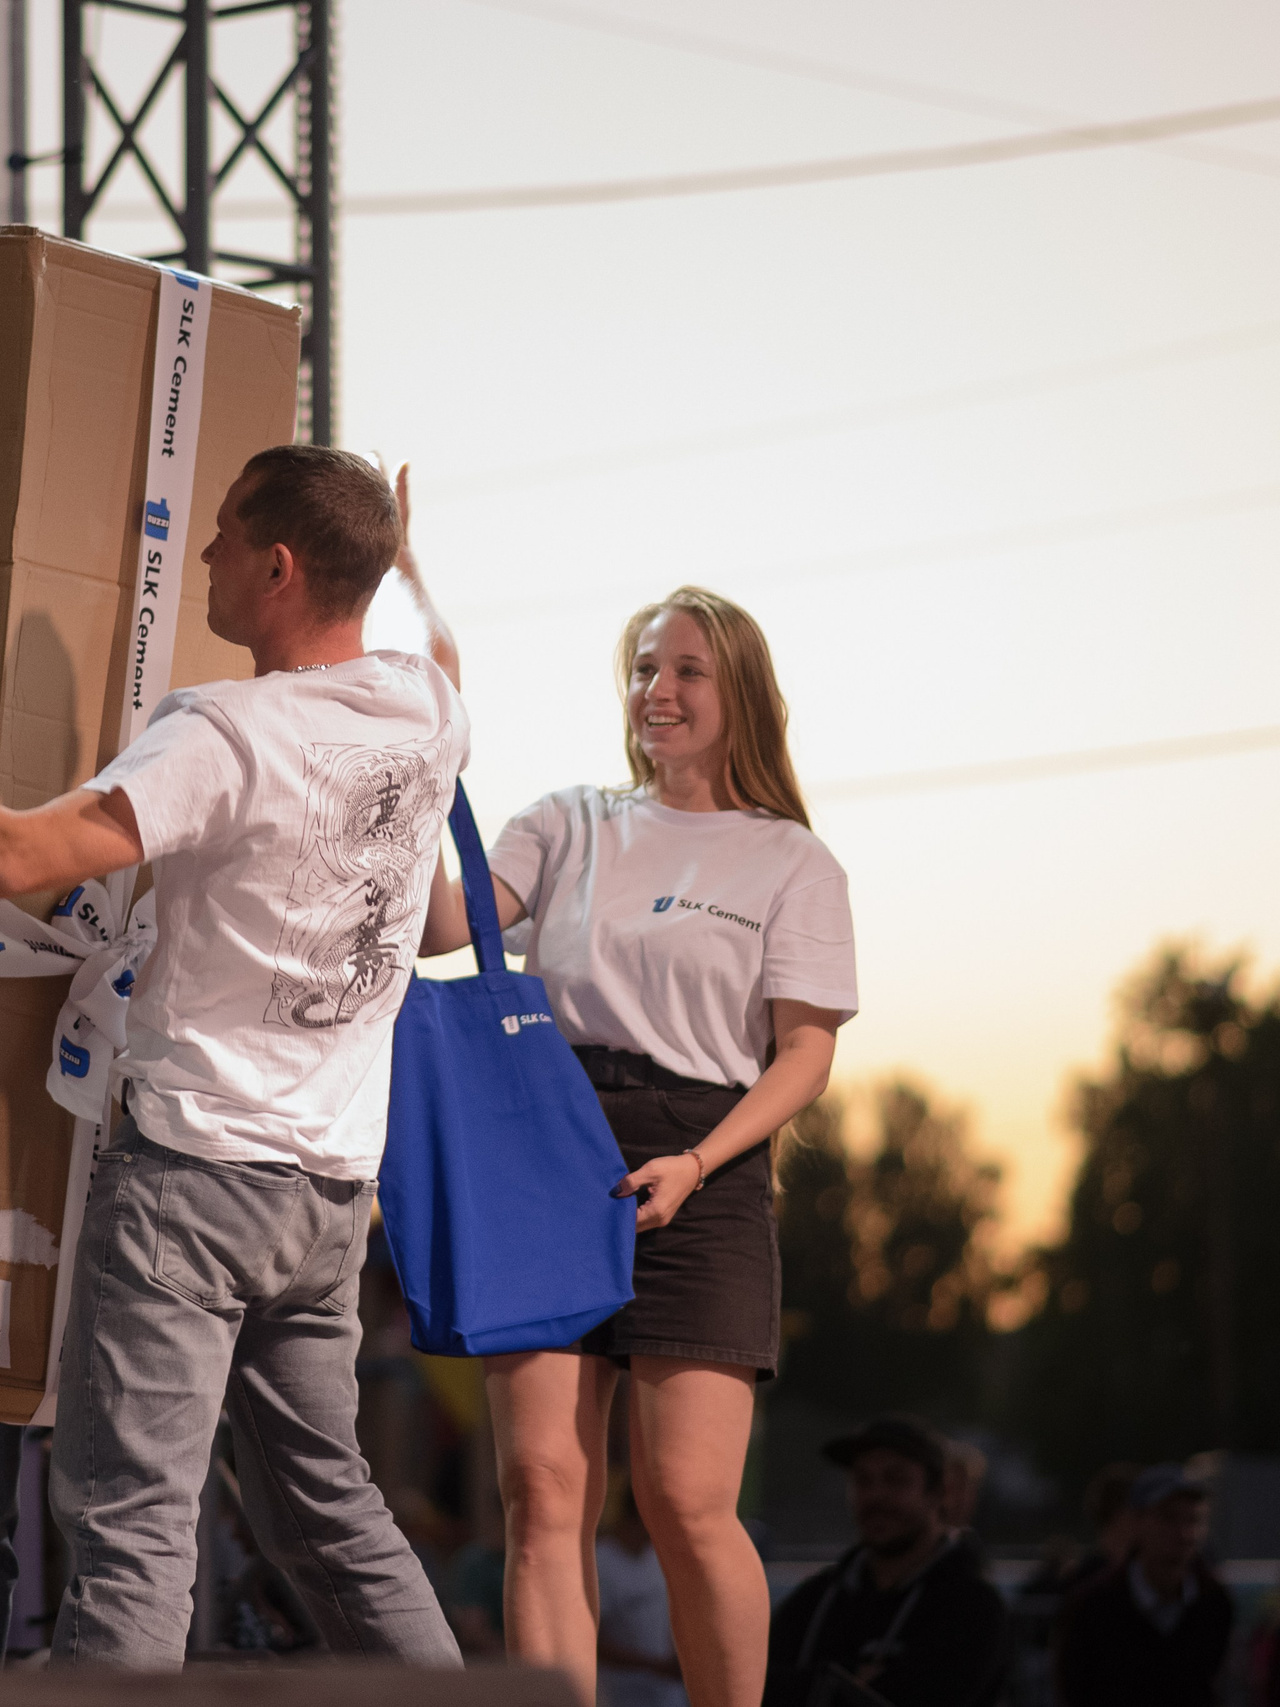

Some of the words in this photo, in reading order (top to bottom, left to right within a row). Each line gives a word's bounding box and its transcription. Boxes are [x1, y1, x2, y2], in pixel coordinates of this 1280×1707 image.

[177, 298, 195, 348] SLK
[161, 355, 189, 459] Cement
[142, 549, 163, 598] SLK
[677, 899, 705, 911] SLK
[707, 904, 762, 933] Cement
[520, 1013, 539, 1025] SLK
